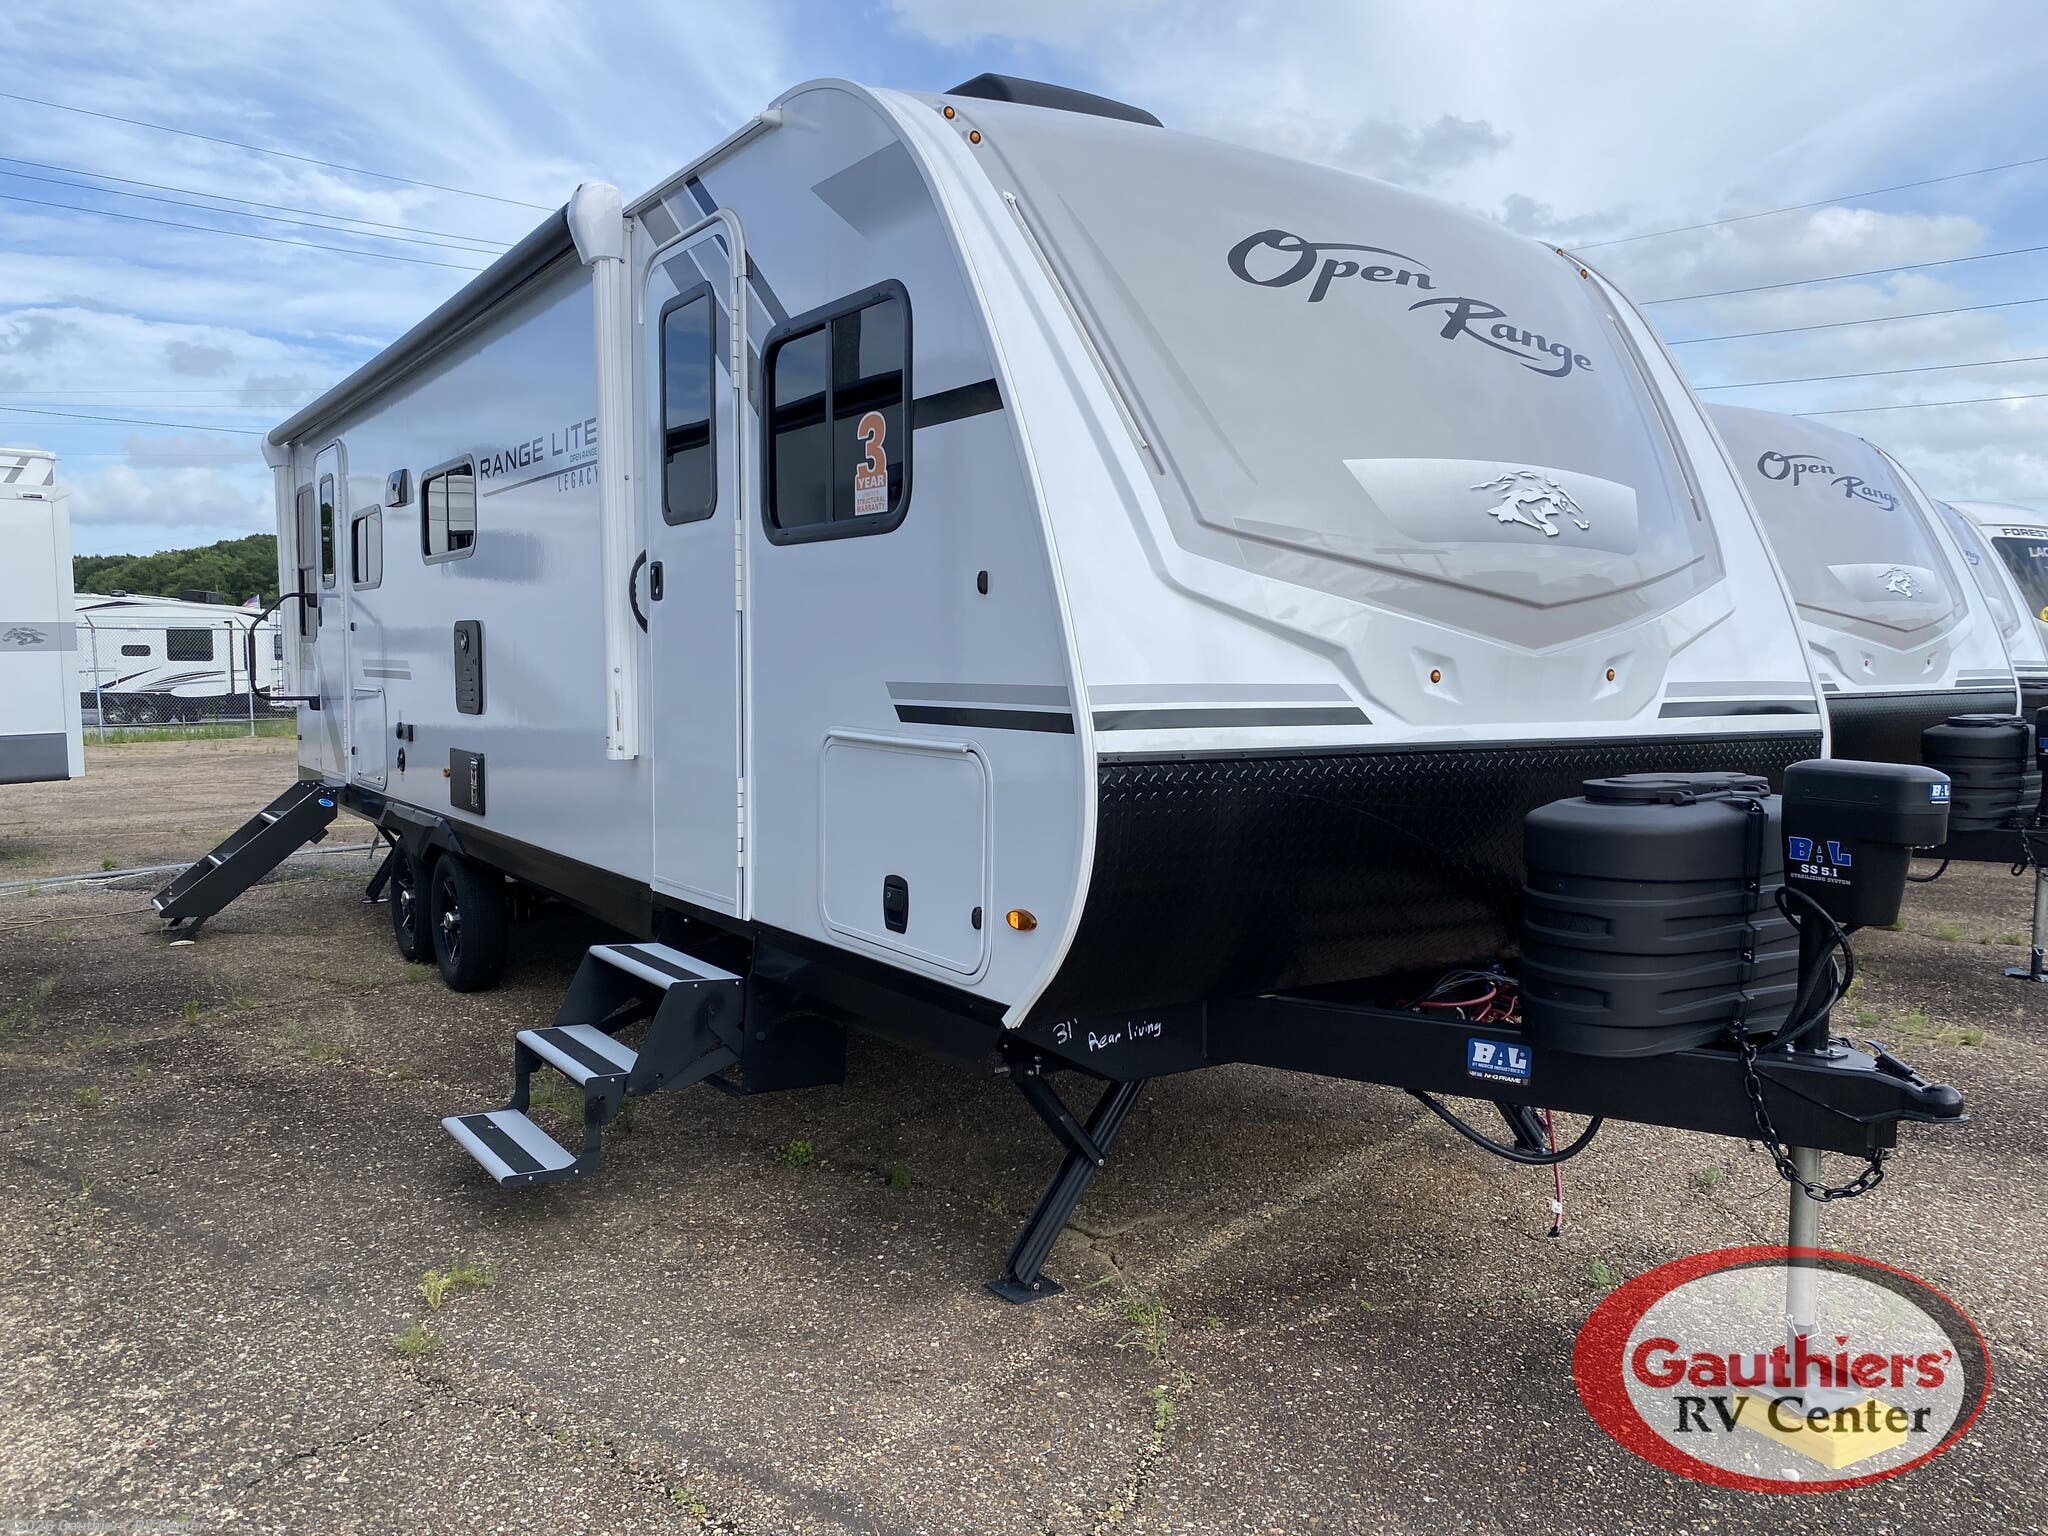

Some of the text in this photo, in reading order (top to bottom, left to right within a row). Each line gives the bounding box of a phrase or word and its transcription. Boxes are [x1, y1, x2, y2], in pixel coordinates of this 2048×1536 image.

[1227, 229, 1437, 303] Open
[1408, 297, 1594, 378] Range
[480, 417, 598, 480] RANGE LITE
[857, 411, 887, 474] 3
[557, 466, 599, 493] LEGACY
[857, 475, 884, 488] YEAR
[1757, 451, 1835, 486] Open
[1831, 476, 1900, 511] Range
[856, 502, 885, 513] WARRANTY
[1788, 836, 1852, 867] BAL
[1790, 872, 1851, 886] STABILIZING SYSTEM
[1801, 863, 1838, 878] SS 5.1
[1127, 1021, 1162, 1041] living
[1473, 1042, 1526, 1069] BAL
[1498, 1075, 1522, 1084] FRAME
